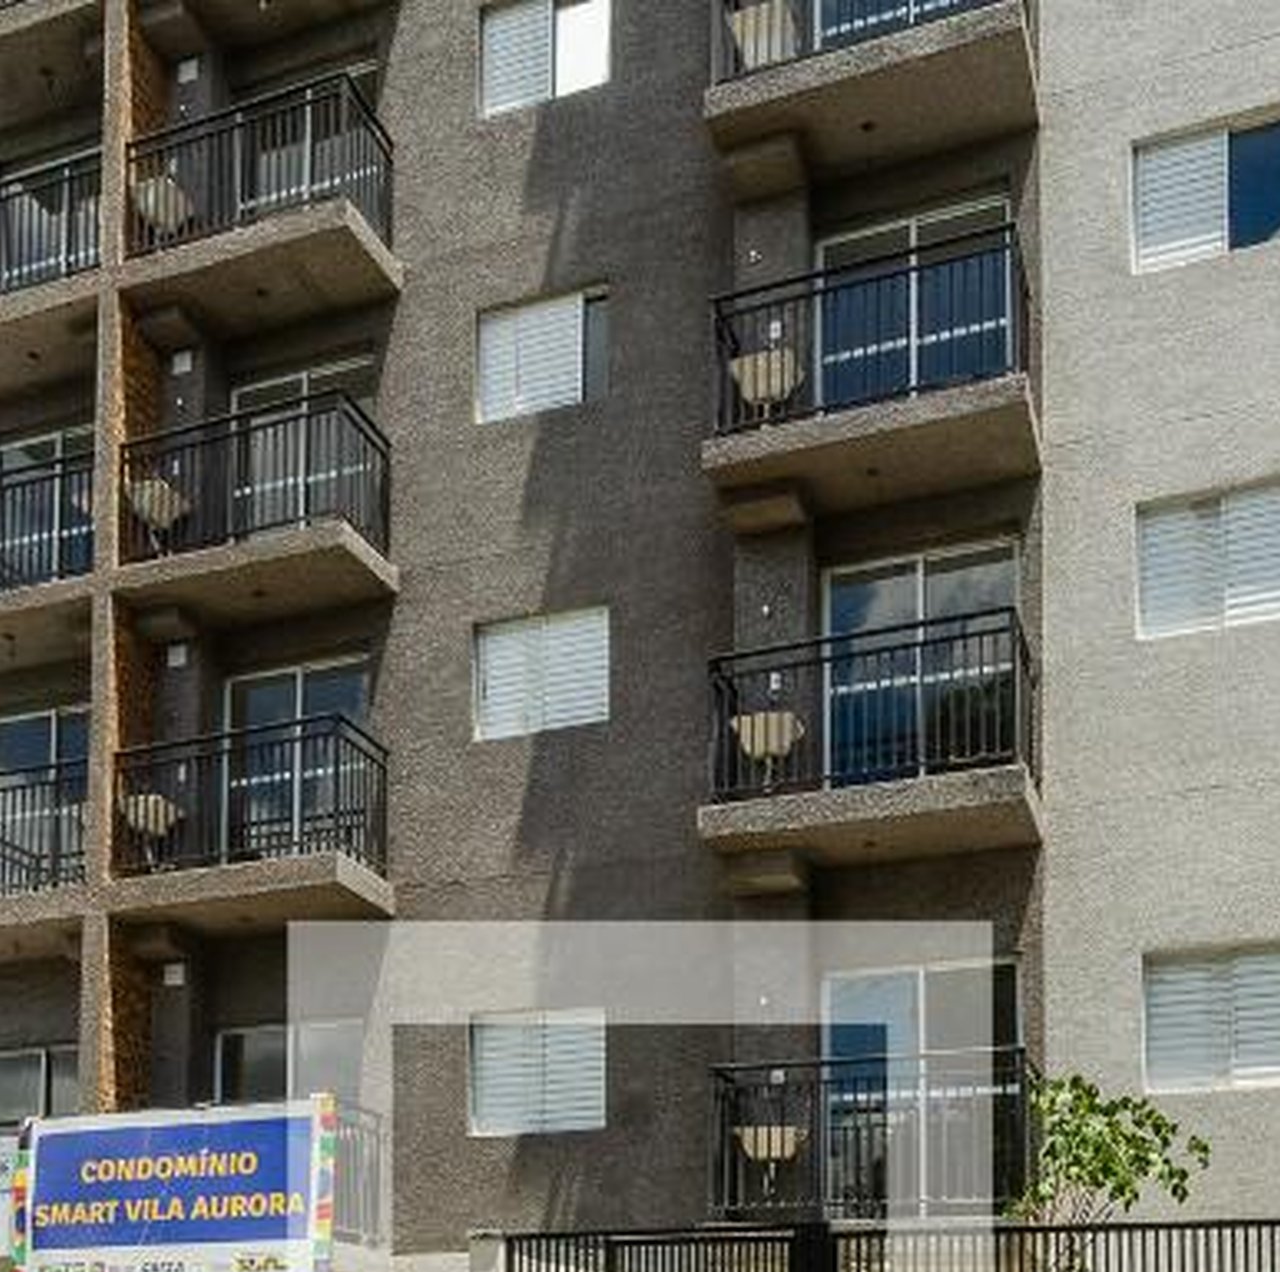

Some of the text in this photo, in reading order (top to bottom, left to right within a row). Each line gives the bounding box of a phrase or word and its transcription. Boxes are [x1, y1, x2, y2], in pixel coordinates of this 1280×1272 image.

[80, 1150, 258, 1184] CONDOMÍNIO
[34, 1193, 305, 1228] SMART VILA AURORA
